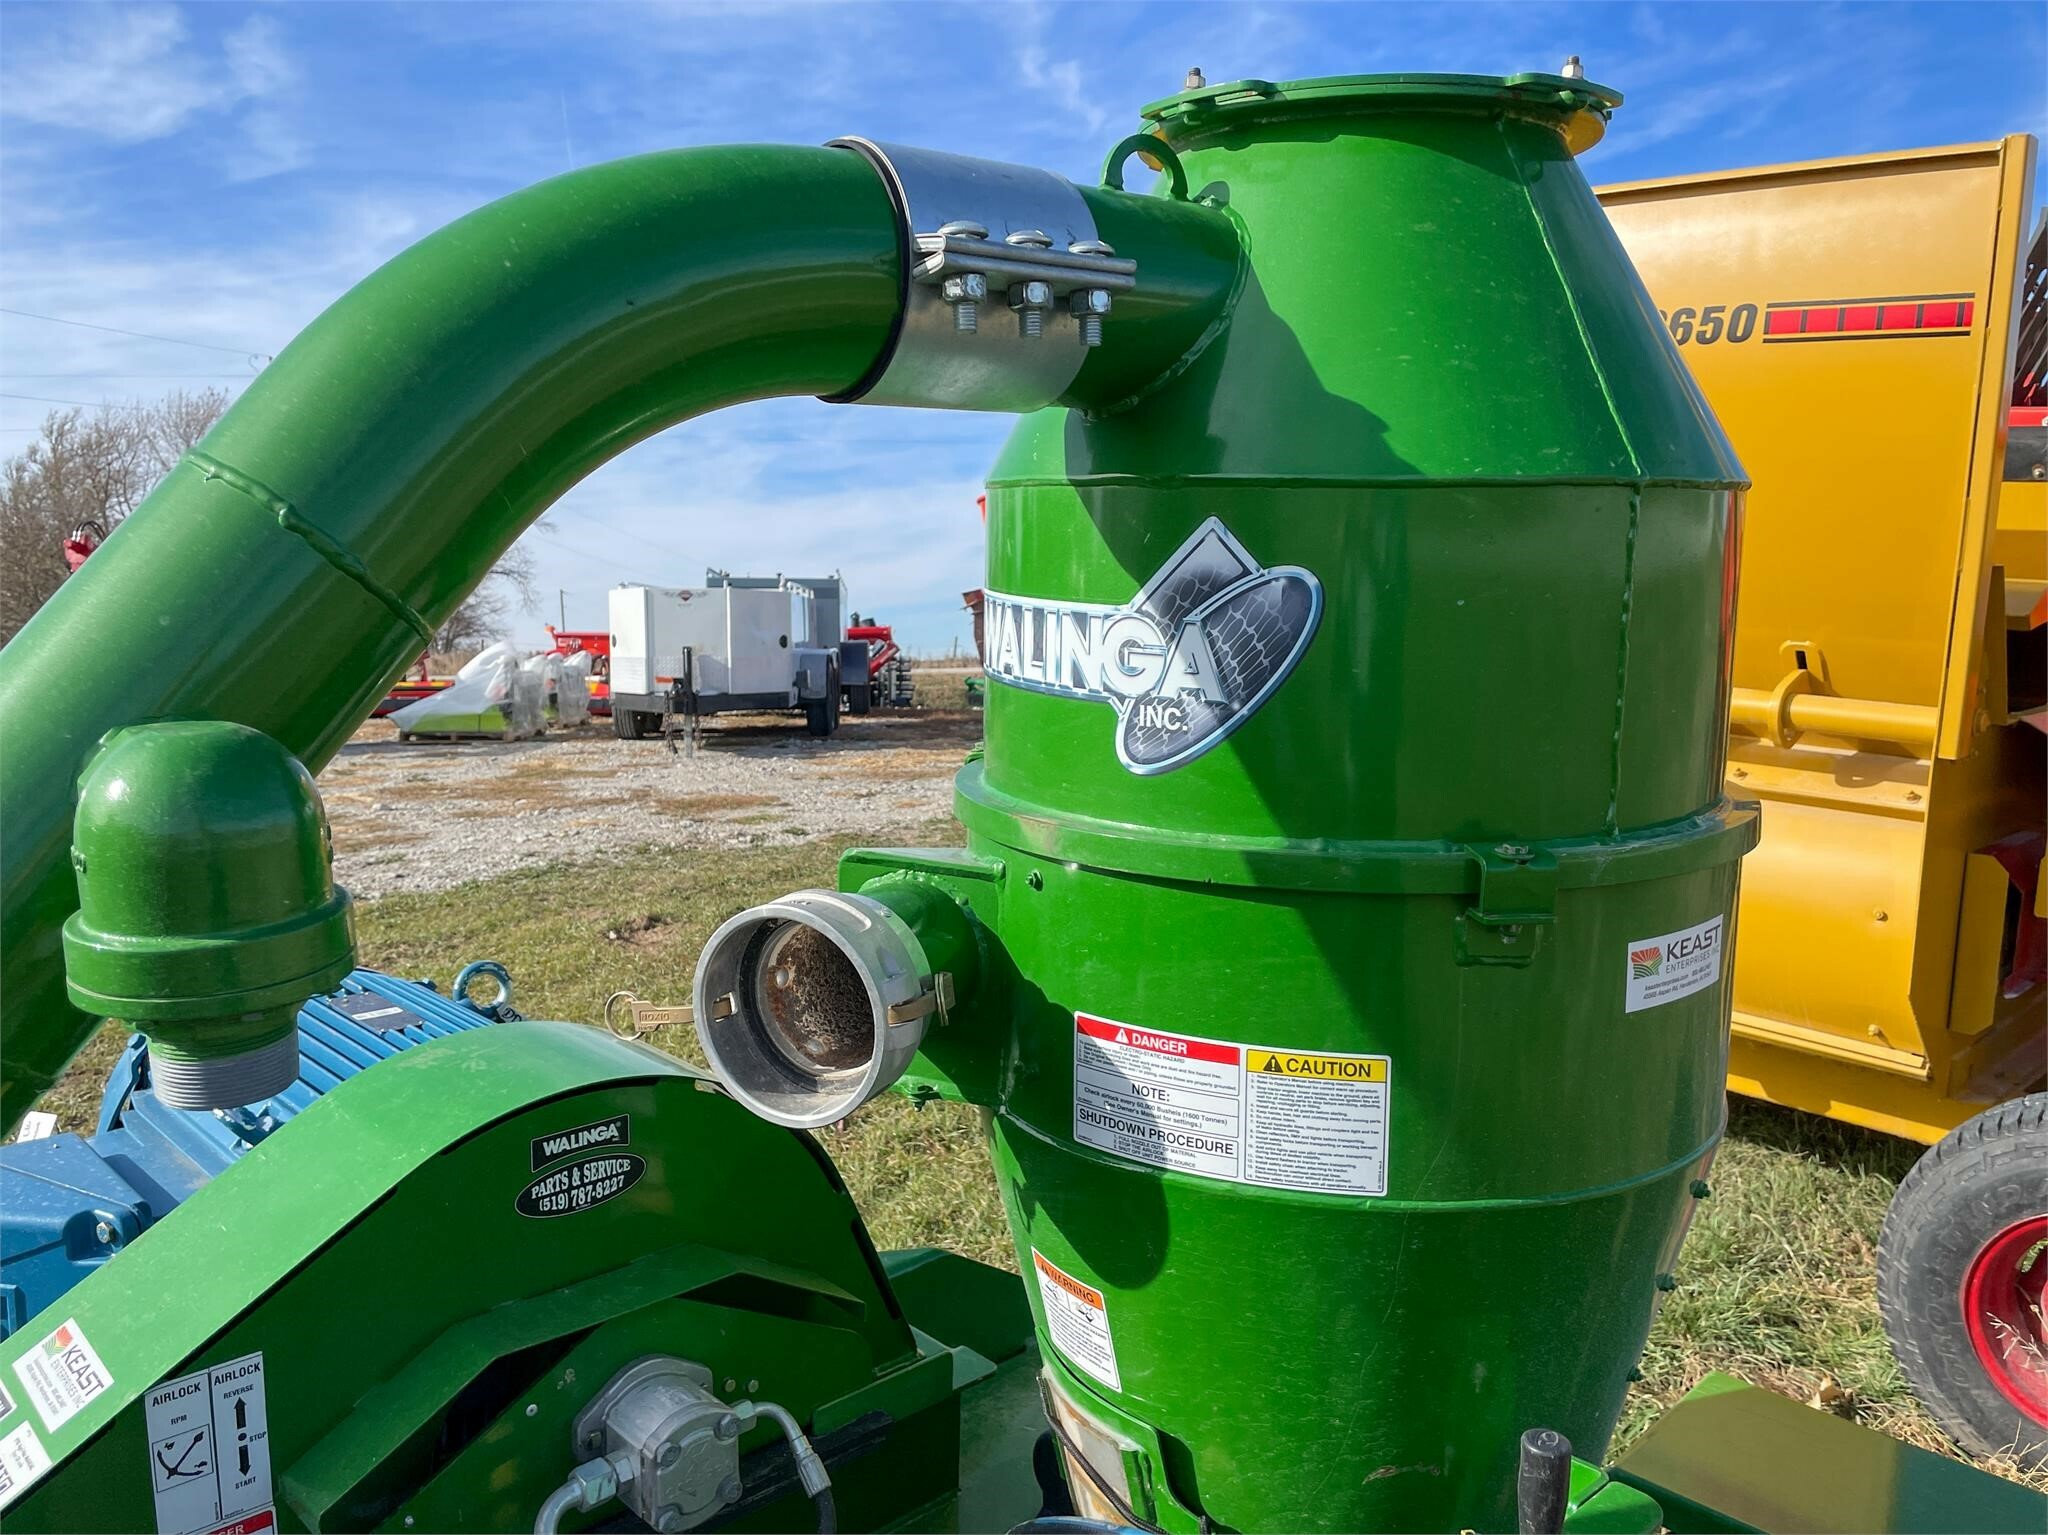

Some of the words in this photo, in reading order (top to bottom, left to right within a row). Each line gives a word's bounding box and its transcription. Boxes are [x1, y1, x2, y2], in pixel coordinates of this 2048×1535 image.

[1658, 303, 1758, 346] 650
[984, 598, 1228, 705] WALINGA
[1138, 704, 1188, 731] INC.
[1667, 924, 1720, 962] KEAST
[1666, 950, 1710, 974] ENTERPRISES
[1132, 1032, 1187, 1055] DANGER
[1286, 1057, 1371, 1078] CAUTION
[1131, 1083, 1170, 1102] NOTE:
[1084, 1086, 1100, 1096] Check
[1120, 1099, 1136, 1107] every
[1157, 1106, 1181, 1117] Bushels
[1202, 1115, 1228, 1126] Tonnes)
[1140, 1110, 1162, 1120] Manual
[542, 1123, 619, 1157] WALINGA
[1080, 1108, 1146, 1137] SHUTDOWN
[1149, 1128, 1234, 1155] PROCEDURE
[531, 1170, 569, 1199] PARTS
[571, 1166, 581, 1187] &
[583, 1159, 631, 1184] SERVICE
[539, 1192, 569, 1211] (519)
[570, 1175, 625, 1207] 787-8227
[1050, 1269, 1094, 1303] WARNING
[61, 1344, 104, 1397] KEAST
[213, 1362, 261, 1387] AIRLOCK
[152, 1382, 202, 1407] AIRLOCK
[223, 1384, 254, 1400] REVERSE
[170, 1414, 188, 1425] RPM
[249, 1431, 267, 1443] STOP
[235, 1476, 257, 1490] START
